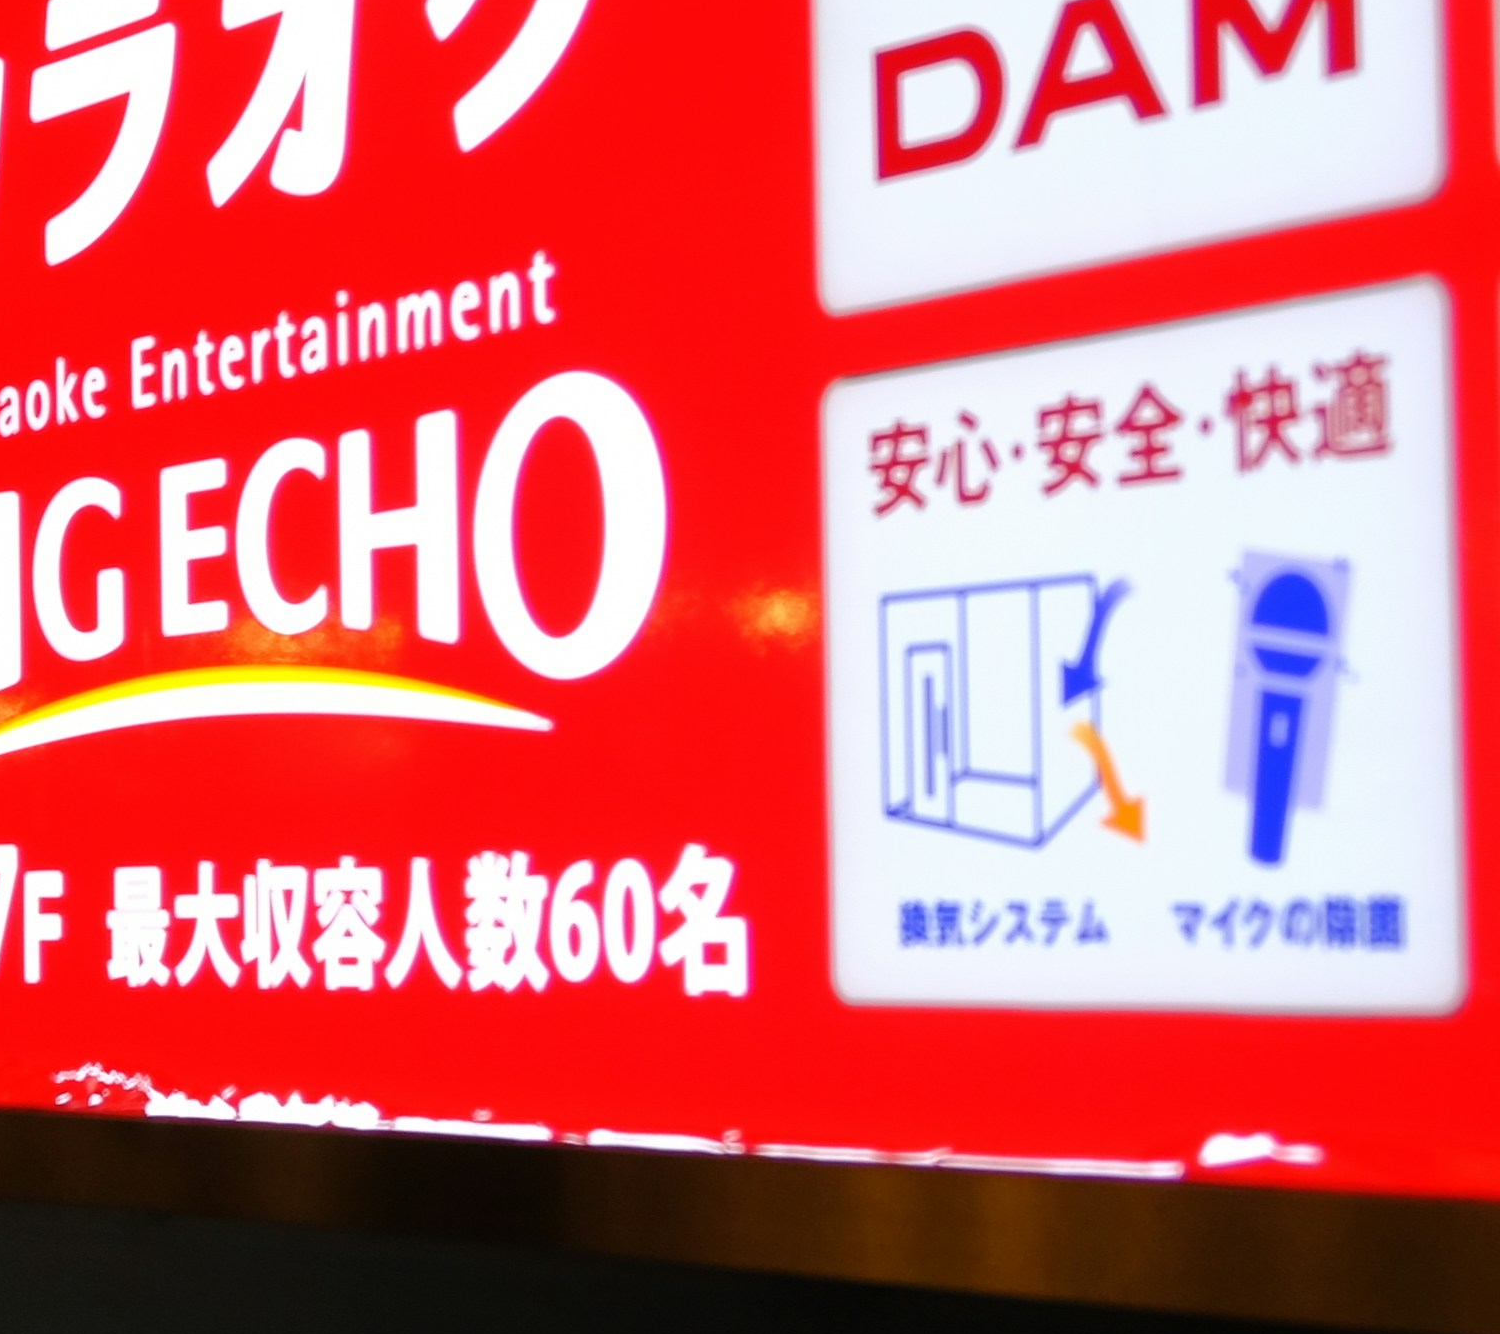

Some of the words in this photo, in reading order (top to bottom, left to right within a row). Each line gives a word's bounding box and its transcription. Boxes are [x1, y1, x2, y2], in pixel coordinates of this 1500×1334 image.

[130, 248, 560, 411] Entertainment
[158, 370, 670, 681] ECHO
[107, 842, 750, 999] 最大収容人数60名
